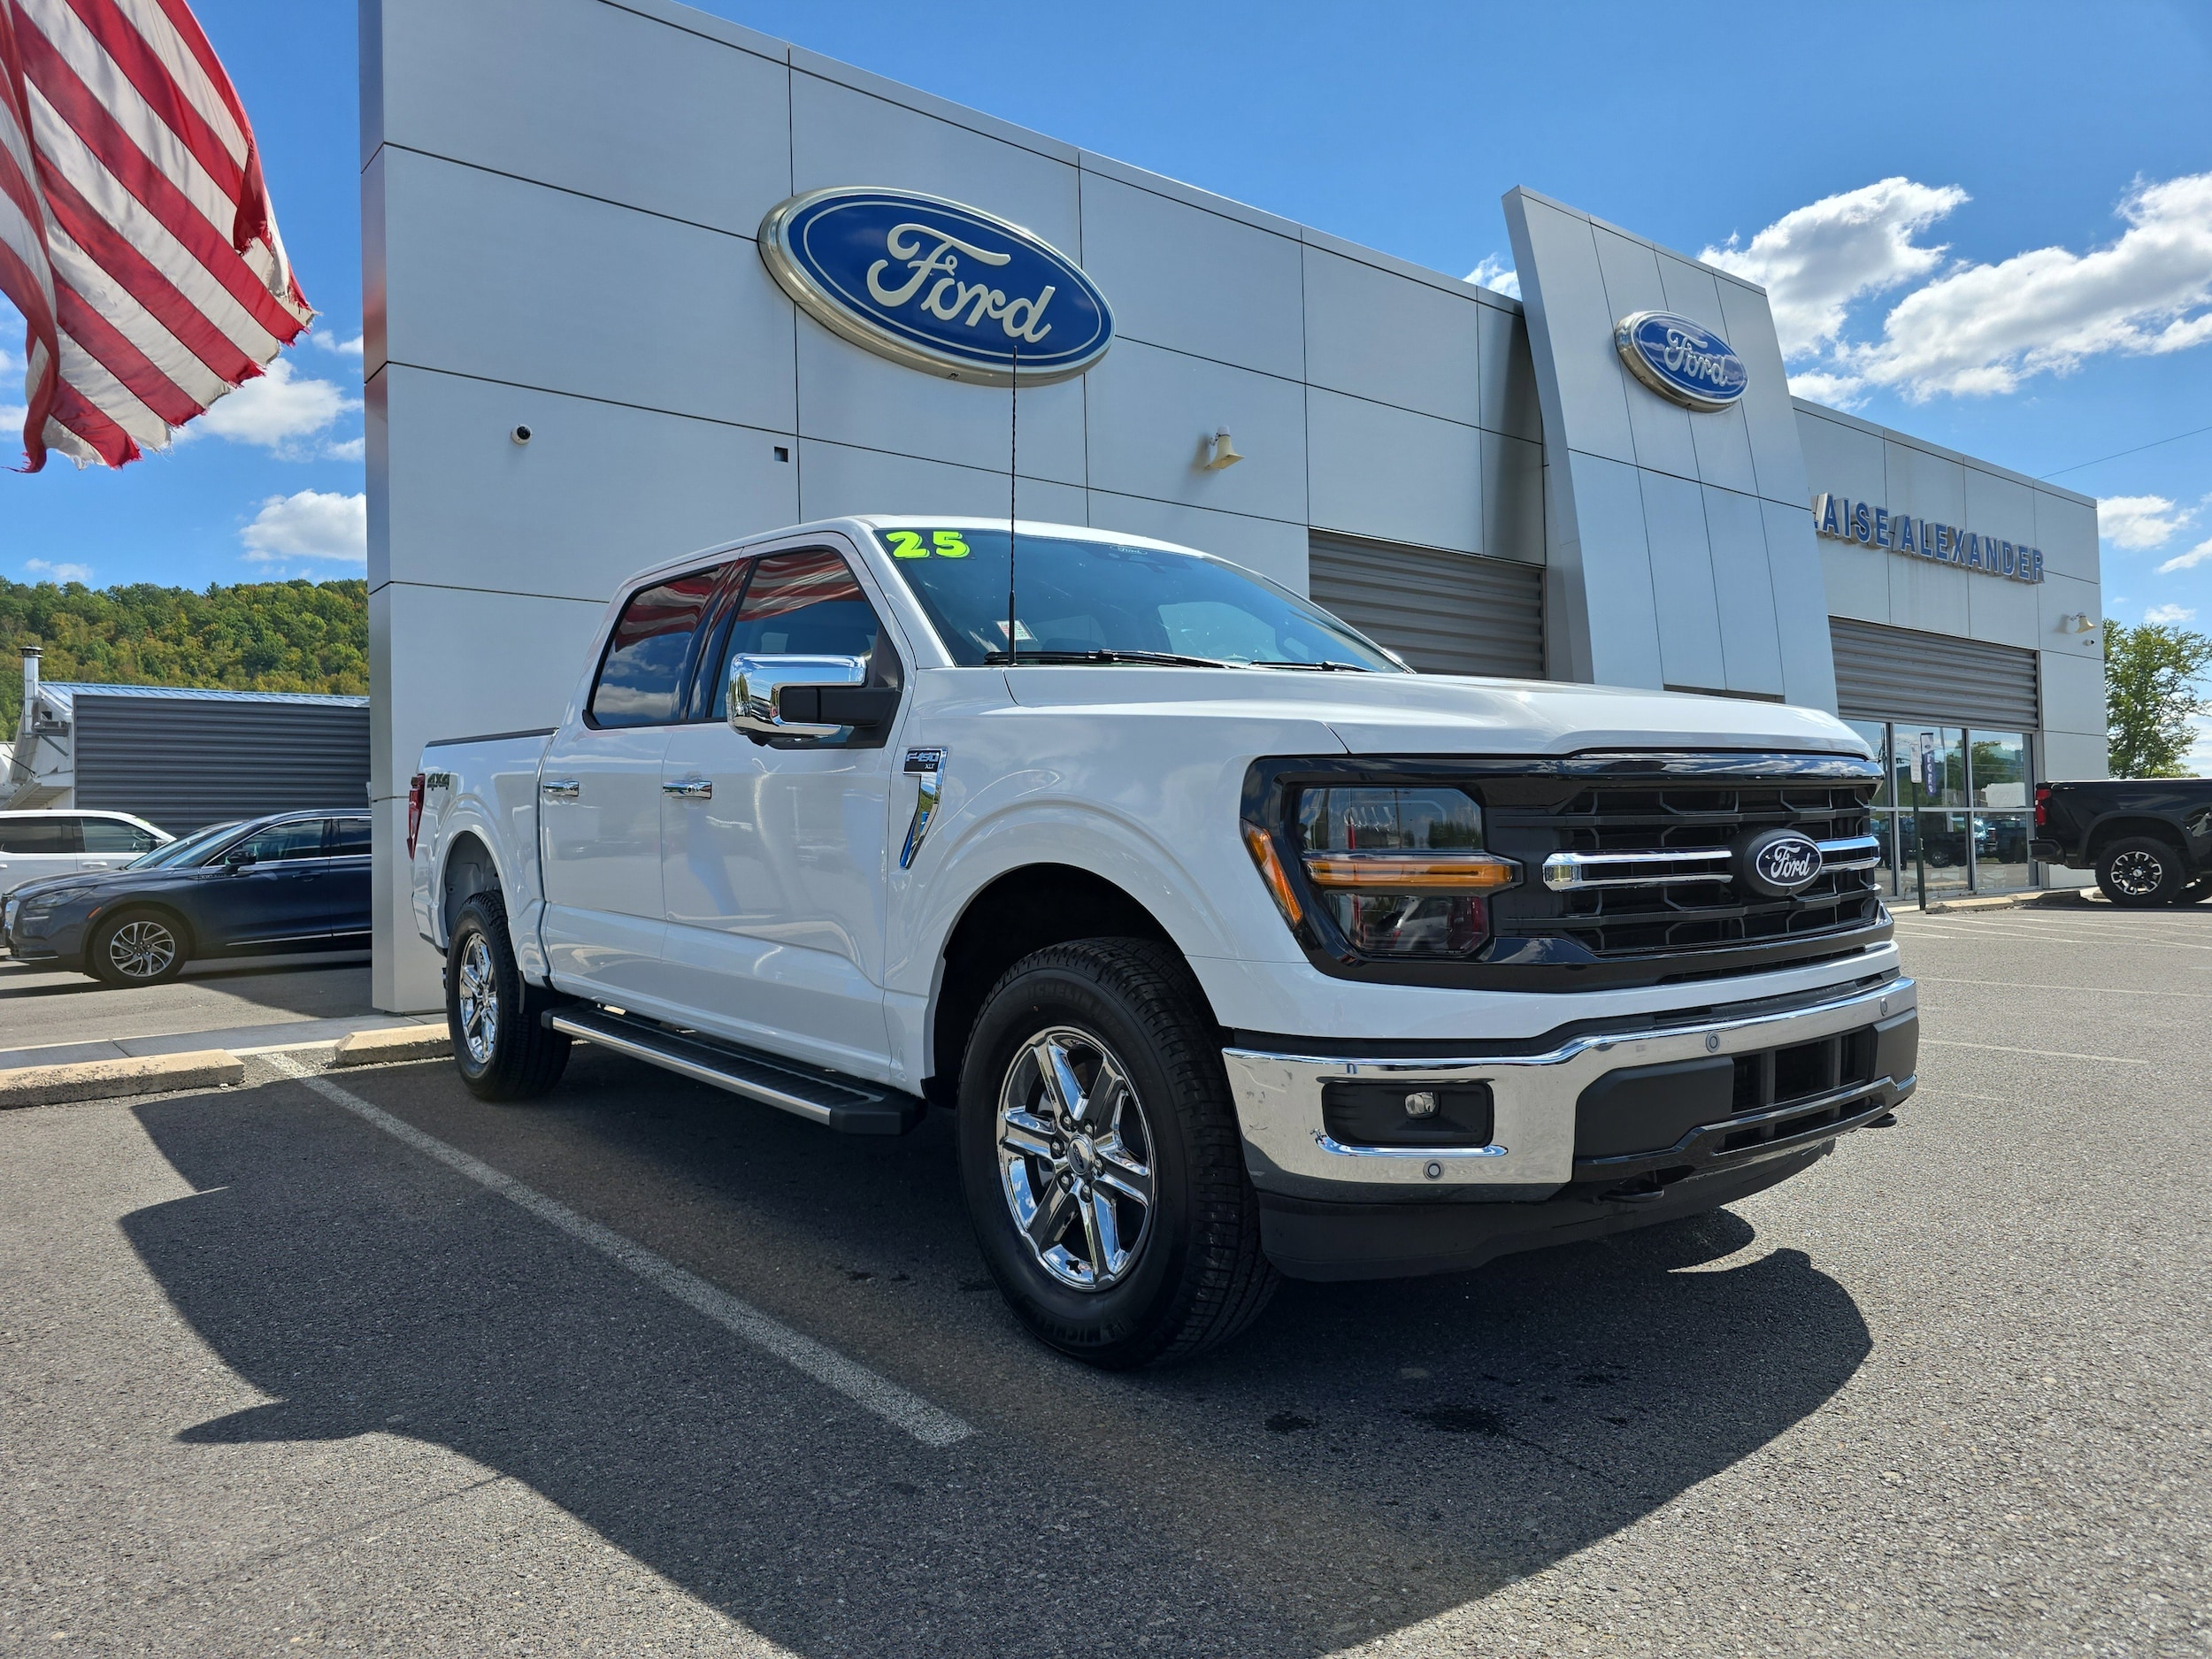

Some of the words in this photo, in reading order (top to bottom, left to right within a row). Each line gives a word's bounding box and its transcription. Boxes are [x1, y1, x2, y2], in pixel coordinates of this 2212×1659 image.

[866, 223, 1056, 343] Ford
[1664, 328, 1728, 387] Ford
[886, 531, 971, 558] 25
[1814, 492, 1891, 549] AISE
[1900, 512, 2045, 584] ALEXANDER
[1770, 846, 1811, 879] Ford
